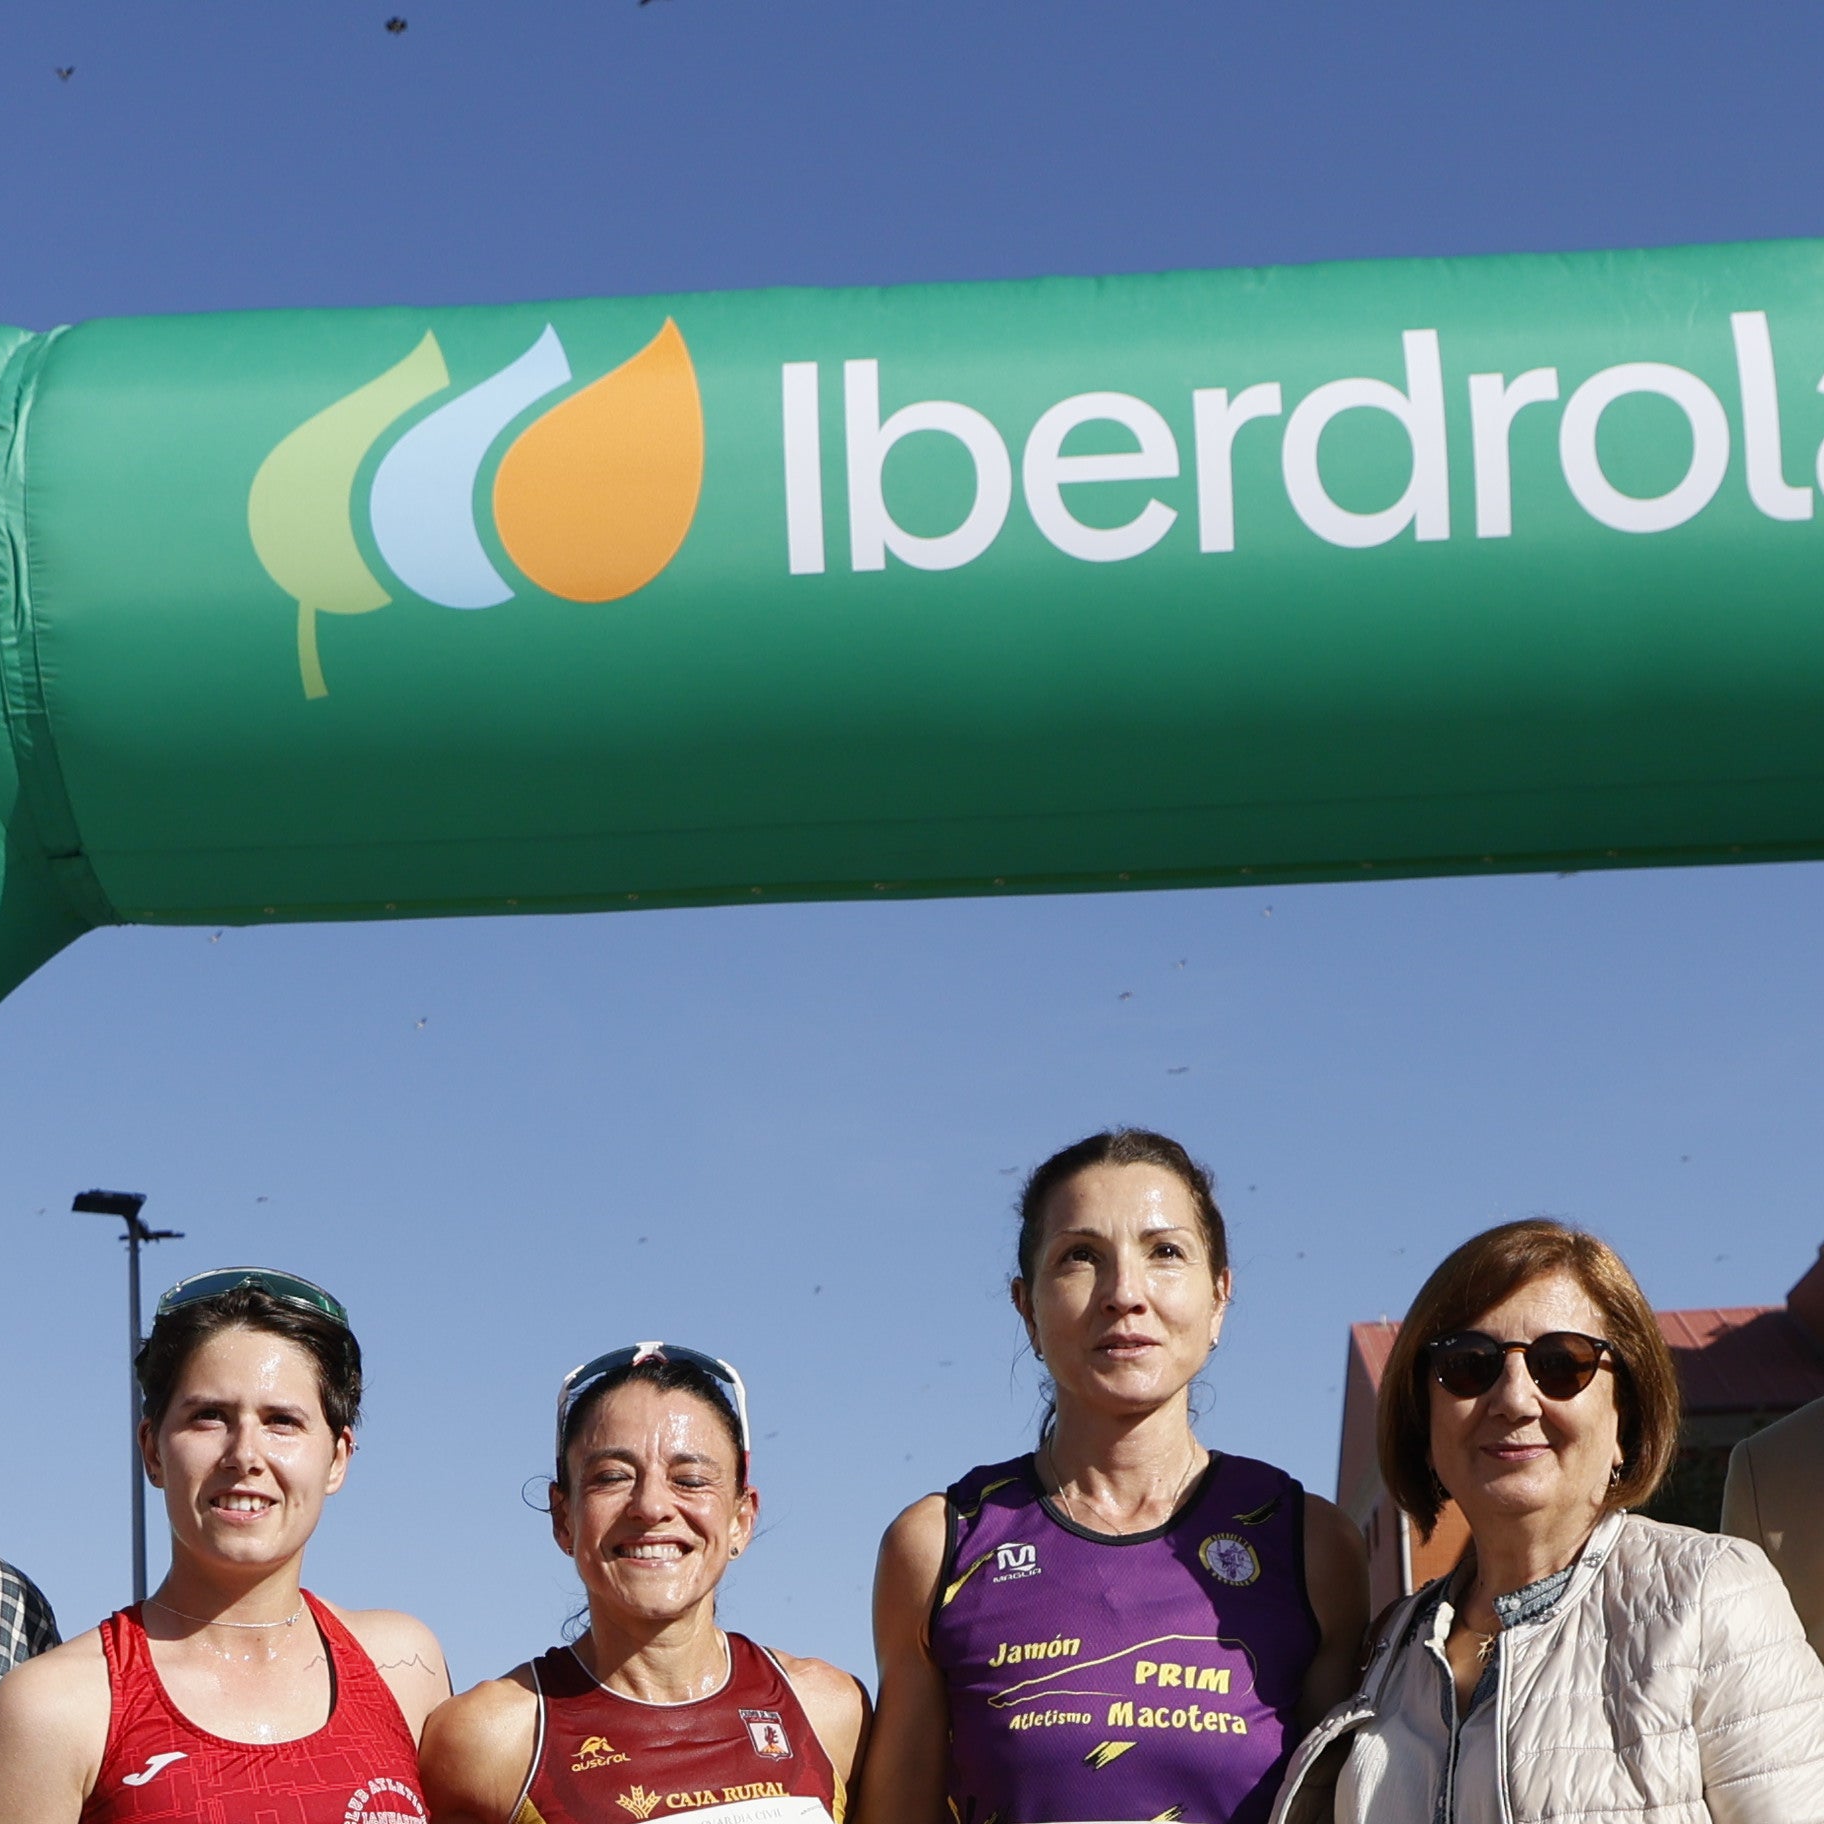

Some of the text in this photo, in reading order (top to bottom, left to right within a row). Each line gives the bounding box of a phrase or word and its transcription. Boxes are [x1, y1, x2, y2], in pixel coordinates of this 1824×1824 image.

[988, 1633, 1081, 1668] Jamón
[1134, 1660, 1231, 1694] PRIM
[1009, 1709, 1092, 1731] Atletismo
[1107, 1701, 1248, 1735] Macotera
[666, 1781, 790, 1809] CAJA RURAL
